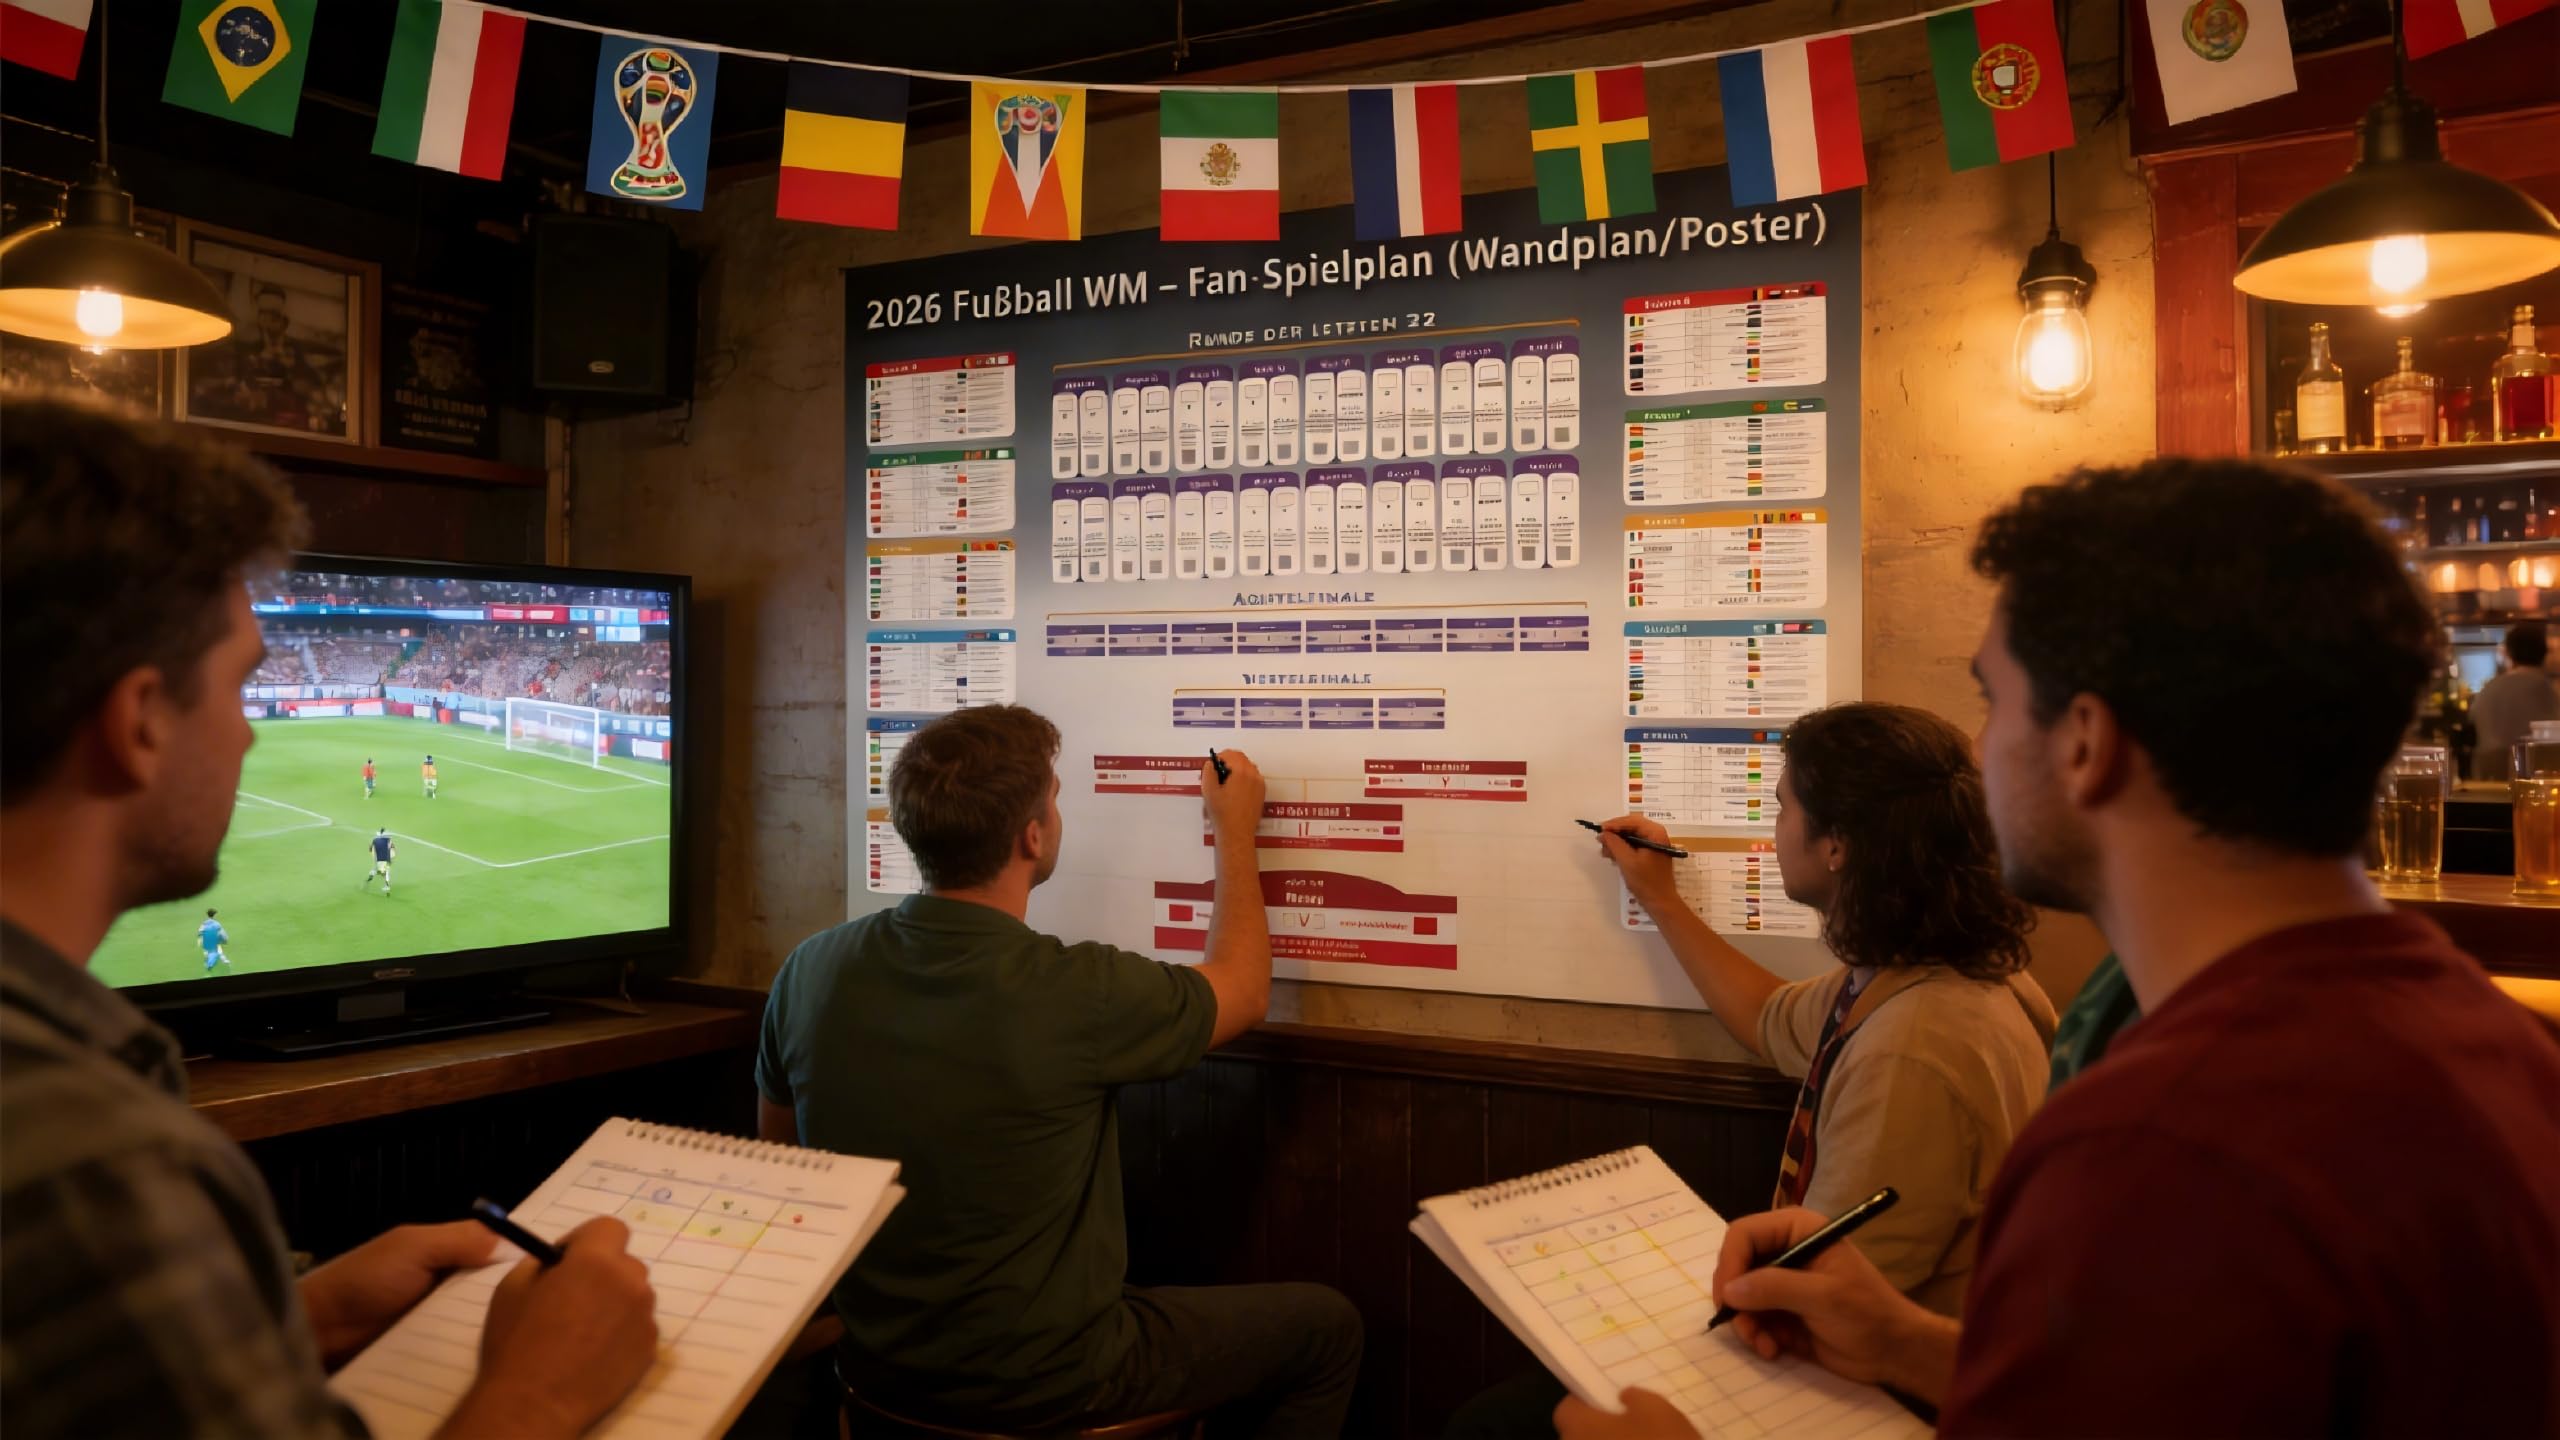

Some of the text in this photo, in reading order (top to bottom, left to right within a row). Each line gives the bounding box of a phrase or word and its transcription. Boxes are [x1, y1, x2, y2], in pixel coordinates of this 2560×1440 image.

[867, 292, 941, 330] 2026
[953, 276, 1072, 321] Fußball
[1083, 271, 1148, 308] WM
[1448, 202, 1827, 280] (Wandplan/Poster)
